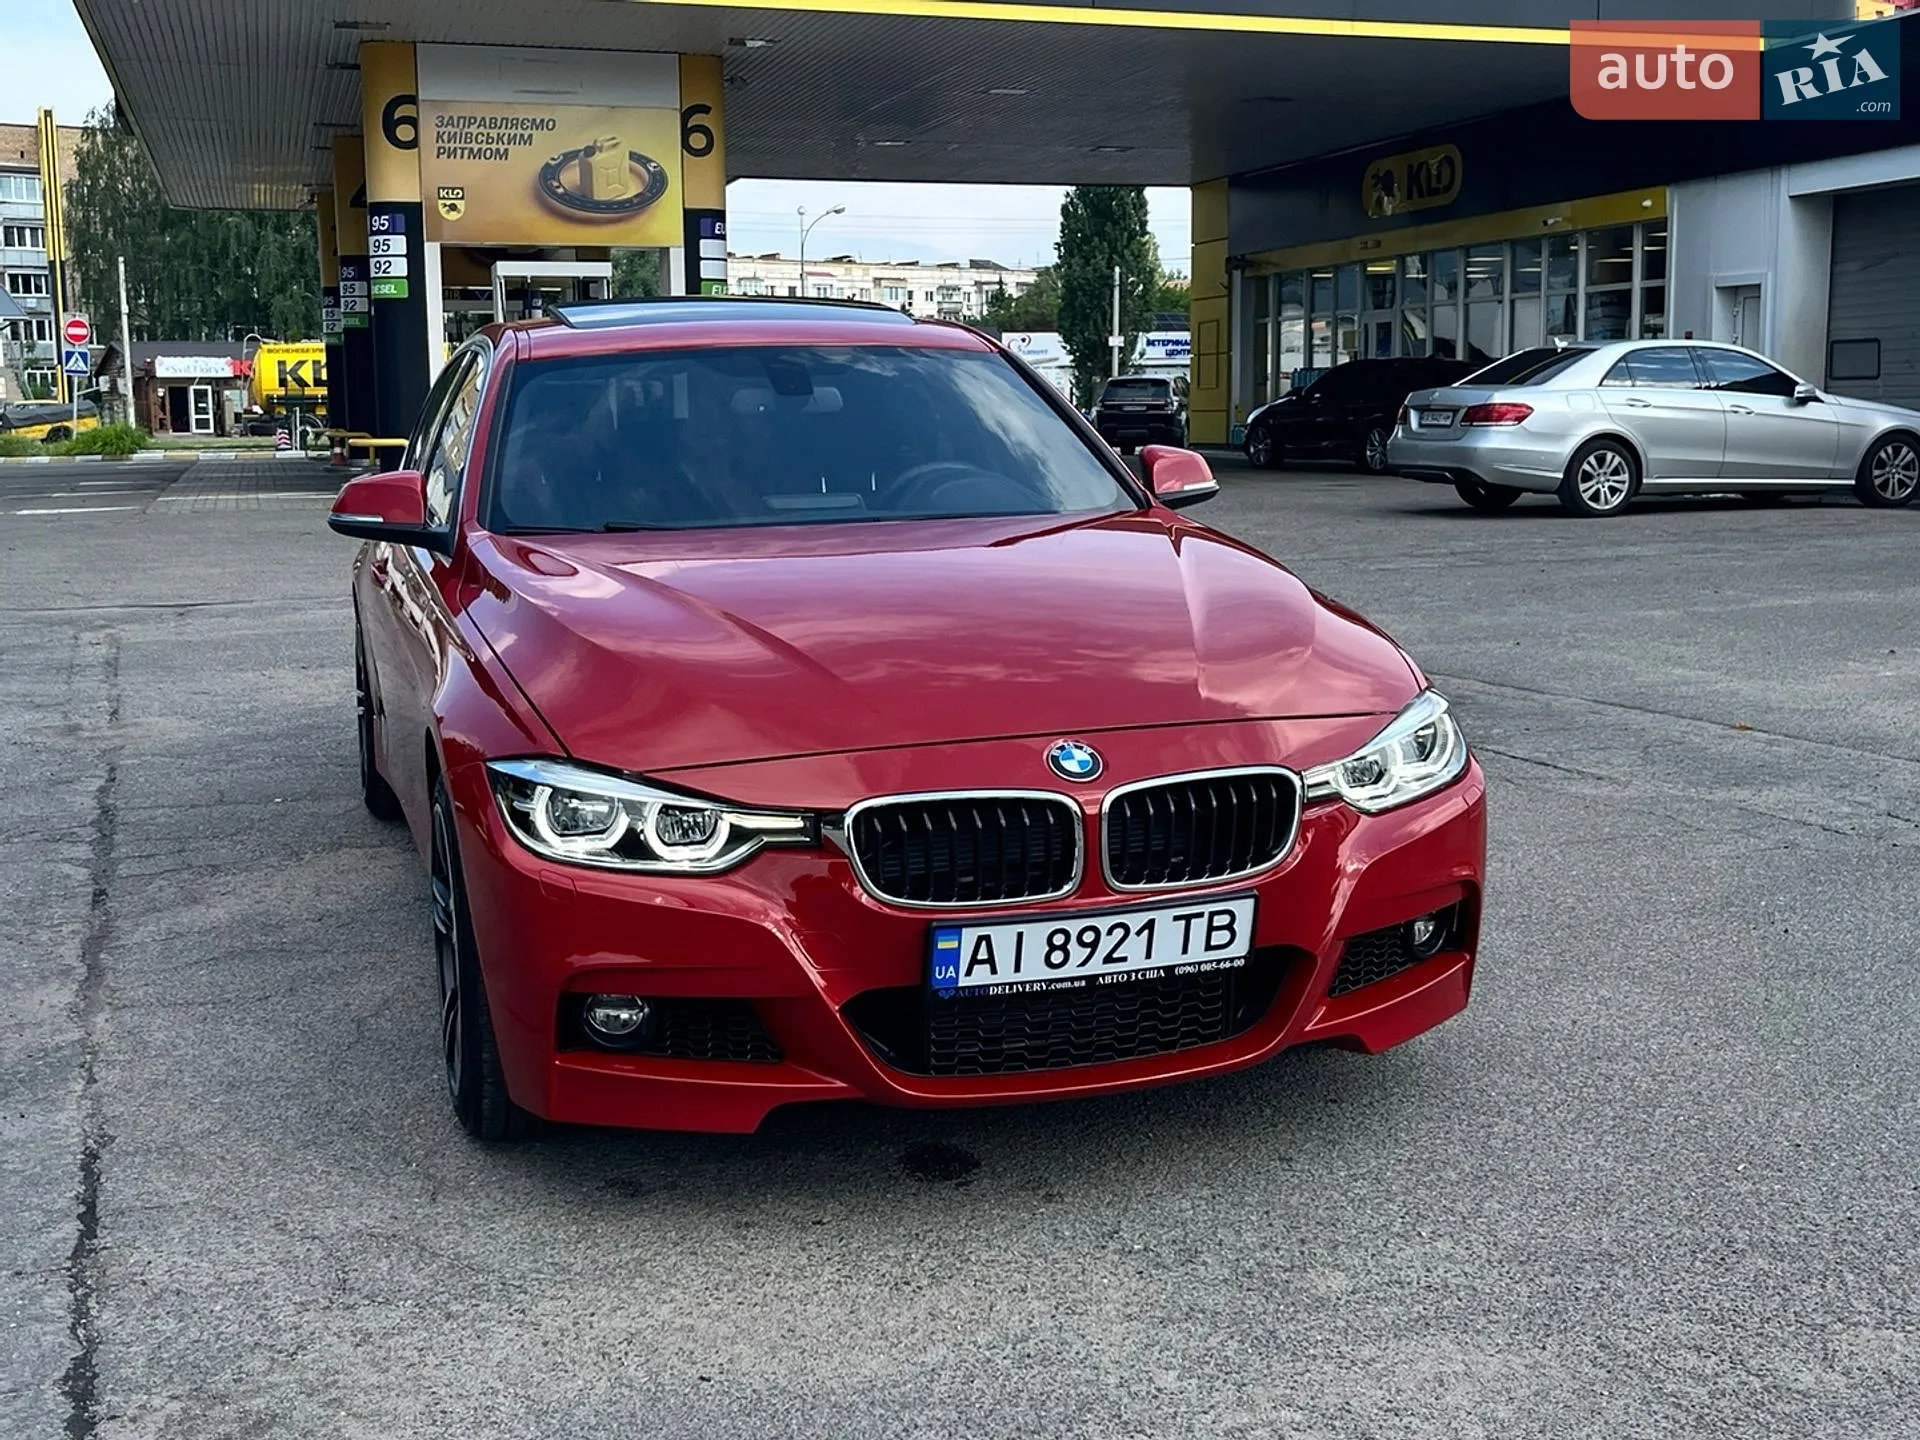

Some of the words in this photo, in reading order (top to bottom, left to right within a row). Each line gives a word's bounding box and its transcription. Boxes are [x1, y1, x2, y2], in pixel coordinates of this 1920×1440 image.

[382, 94, 418, 149] 6
[435, 115, 556, 132] ЗАПРАВЛЯЄМО
[681, 104, 715, 157] 6
[435, 130, 533, 146] КИЇВСЬКИМ
[436, 146, 509, 160] РИТМОМ
[440, 189, 463, 198] KLO
[372, 215, 389, 231] 95
[373, 239, 391, 253] 95
[341, 267, 355, 278] 95
[374, 260, 392, 274] 92
[342, 284, 356, 294] 95
[372, 284, 398, 295] ESEL
[343, 300, 357, 311] 92
[1146, 339, 1191, 347] ВЕТЕРИНА
[964, 931, 1025, 977] AI
[1044, 918, 1156, 970] 8921
[1172, 909, 1237, 955] TB
[935, 965, 956, 979] UA
[1096, 973, 1128, 985] АВТО
[1138, 969, 1165, 980] США
[1174, 964, 1199, 976] (096)
